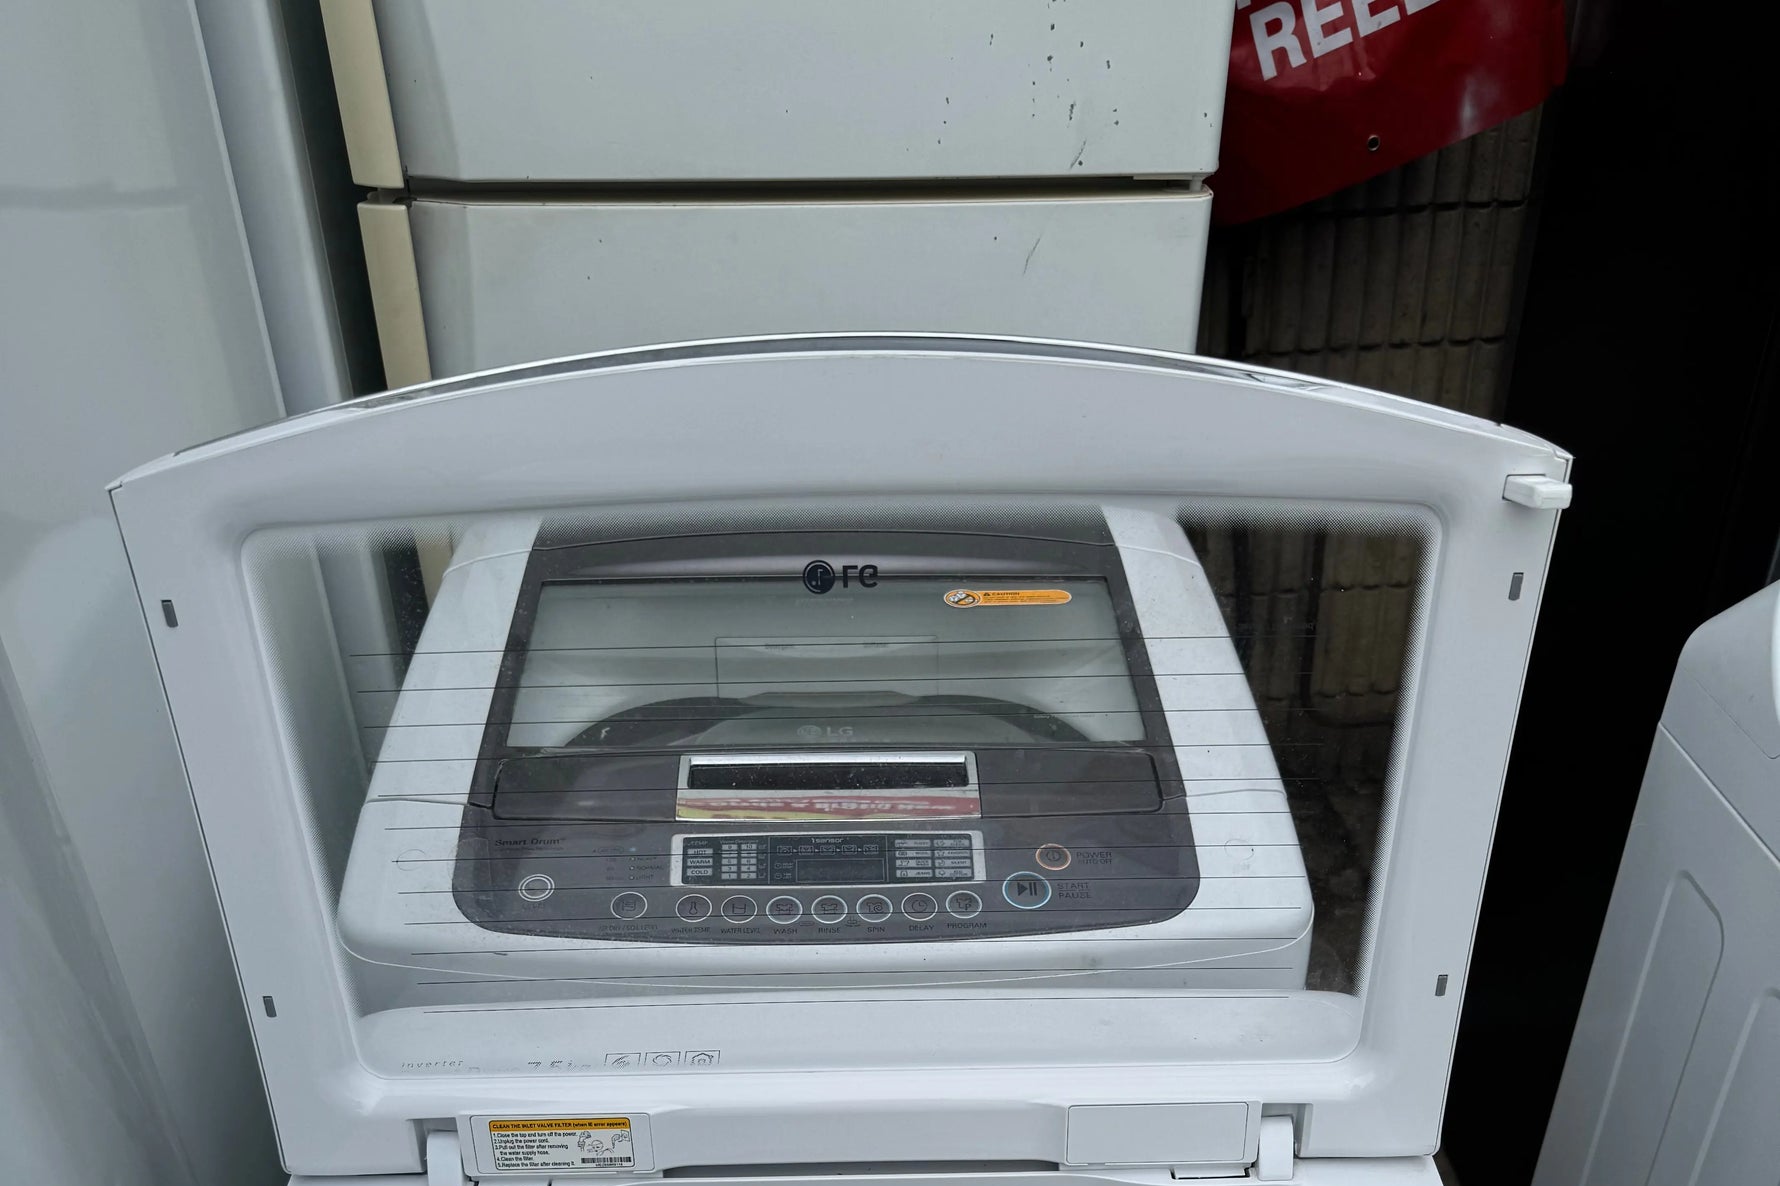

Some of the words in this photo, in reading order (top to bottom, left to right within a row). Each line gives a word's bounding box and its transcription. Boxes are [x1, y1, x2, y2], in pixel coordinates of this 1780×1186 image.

[826, 726, 854, 737] LG
[495, 839, 526, 847] Smart
[1057, 882, 1089, 890] START
[1058, 891, 1091, 899] PAUSE
